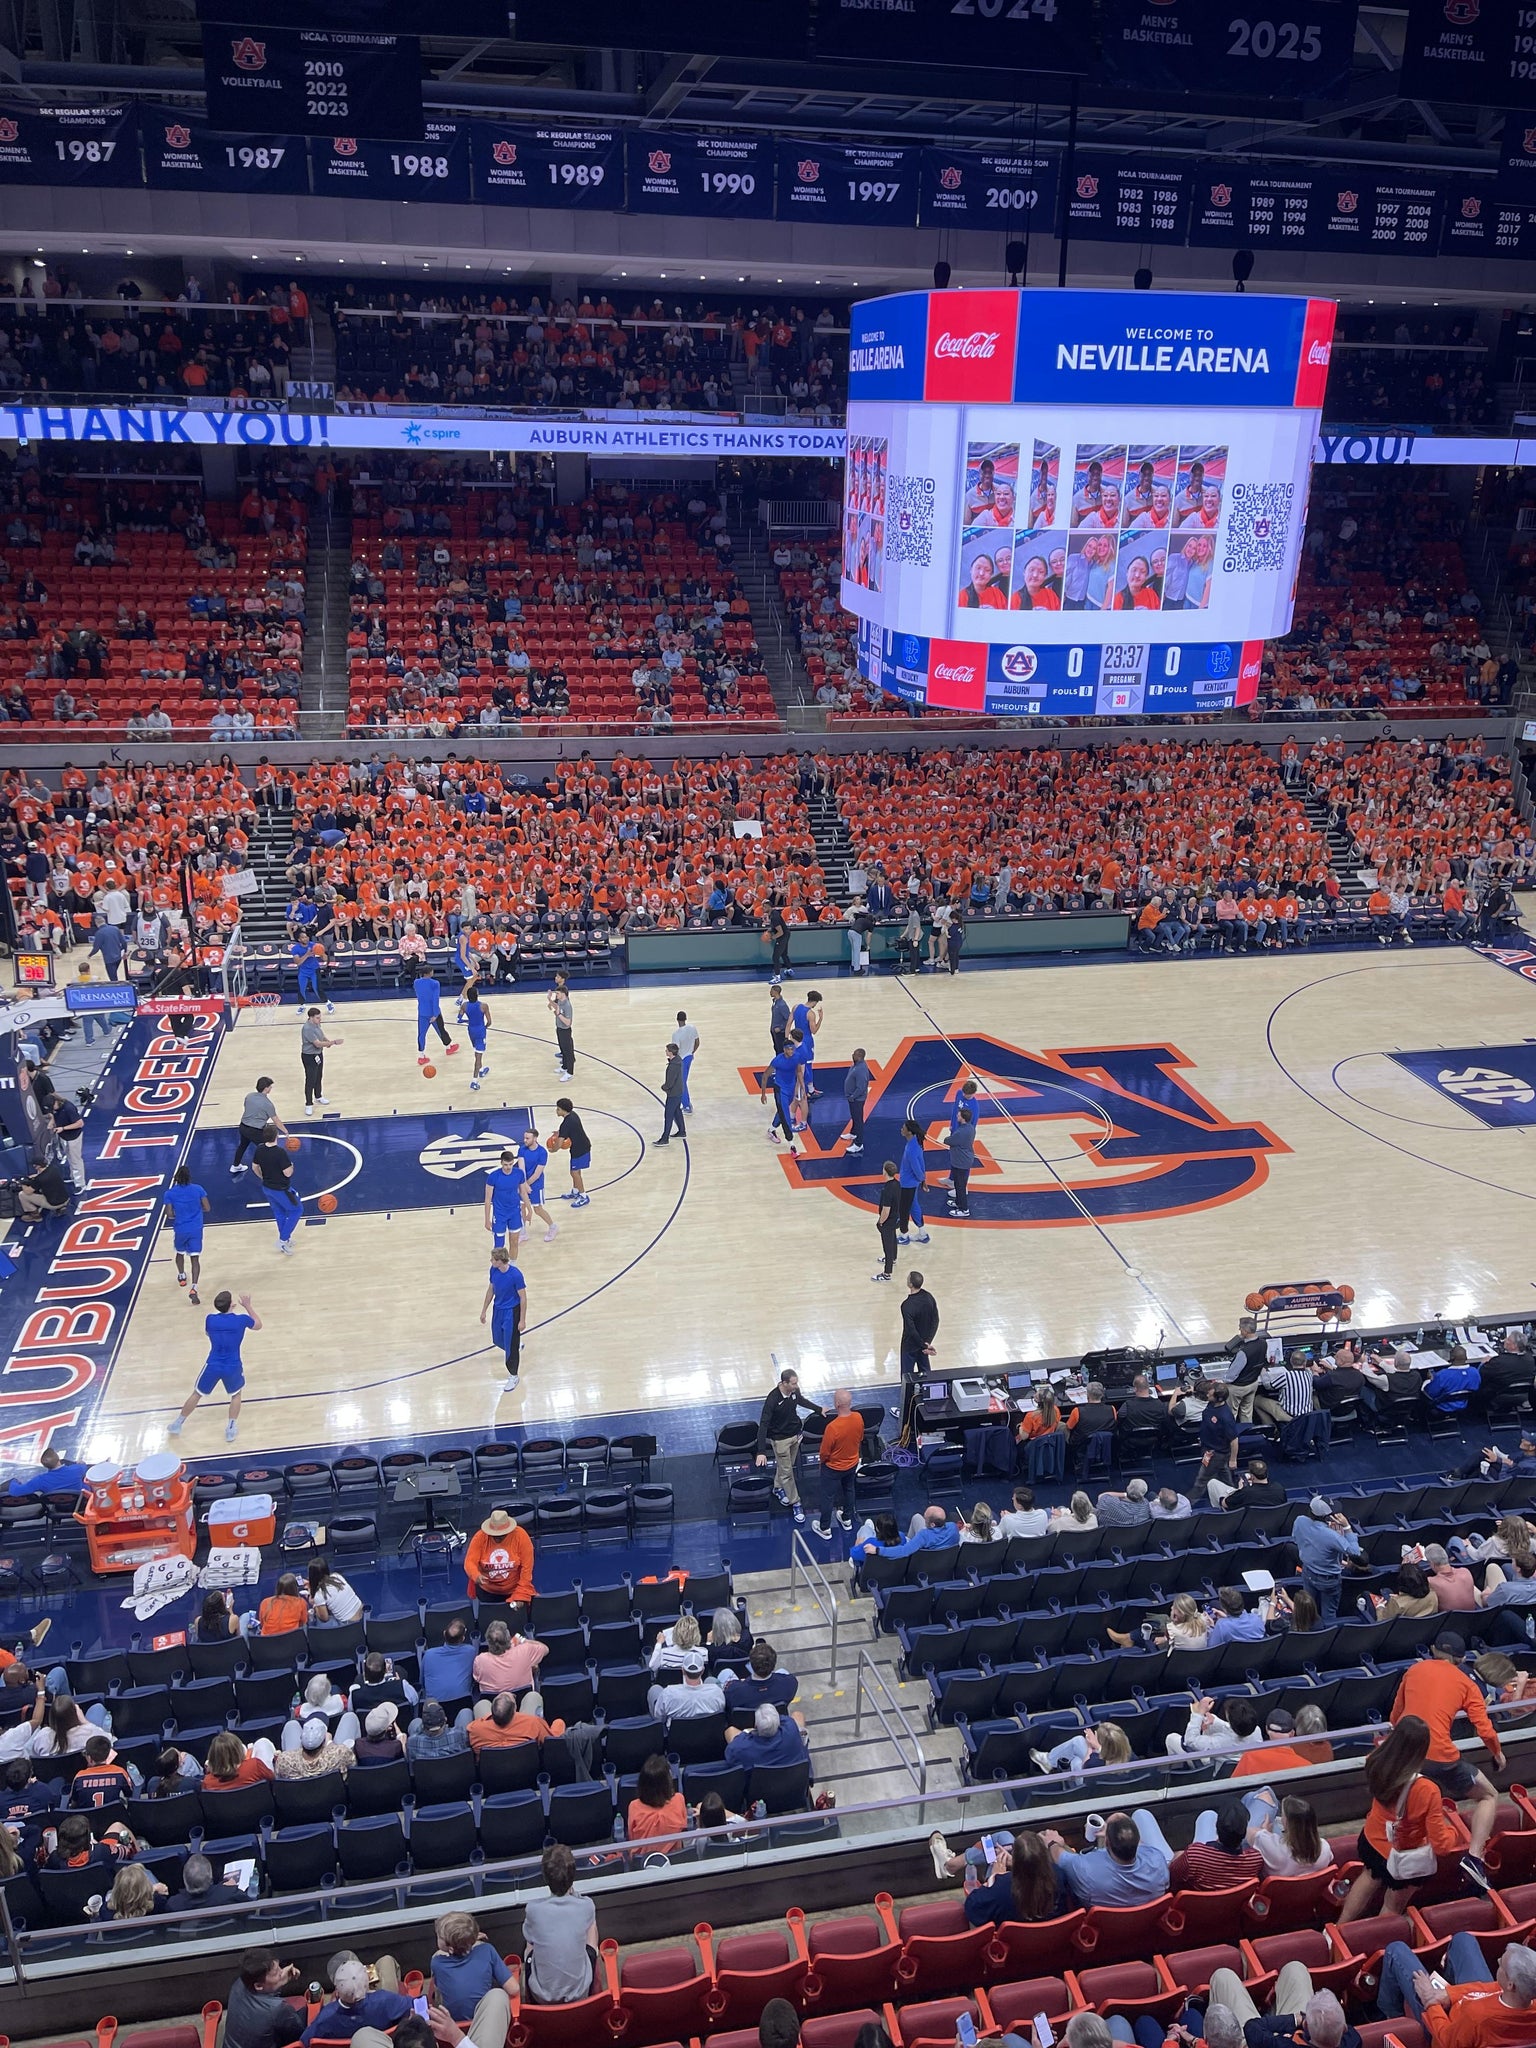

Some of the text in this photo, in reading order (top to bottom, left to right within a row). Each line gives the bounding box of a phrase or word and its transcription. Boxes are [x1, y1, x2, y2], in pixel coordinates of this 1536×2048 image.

[1140, 14, 1178, 28] MEN'S
[301, 32, 397, 45] NCAA TOURNAMENT
[1123, 27, 1193, 46] BASKETBALL
[1227, 18, 1321, 61] 2025
[1439, 32, 1473, 46] MEN'S
[1424, 46, 1486, 62] BASKETBALL
[305, 61, 343, 77] 2010
[221, 76, 283, 89] VOLLEYBALL
[306, 81, 348, 97] 2022
[307, 100, 349, 117] 2023
[59, 117, 106, 126] CHAMPIONS
[427, 124, 456, 132] SEASON
[550, 132, 582, 140] REGULAR
[584, 133, 611, 141] SEASON
[553, 140, 596, 149] CHAMPIONS
[711, 141, 757, 150] TOURNAMENT
[55, 141, 116, 162] 1987
[164, 153, 199, 161] WOMEN'S
[226, 147, 285, 168] 1987
[706, 149, 748, 158] CHAMPIONS
[857, 150, 903, 159] TOURNAMENT
[161, 161, 203, 169] BASKETBALL
[331, 160, 365, 168] WOMEN'S
[391, 155, 449, 178] 1988
[854, 159, 894, 167] CHAMPIONS
[328, 168, 368, 177] BASKETBALL
[490, 169, 523, 177] WOMEN'S
[549, 164, 604, 187] 1989
[1118, 170, 1183, 181] NCAA TOURNAMENT
[488, 177, 526, 186] BASKETBALL
[645, 177, 676, 186] WOMEN'S
[701, 173, 755, 195] 1990
[1250, 180, 1312, 190] NCAA TOURNAMENT
[642, 185, 679, 194] BASKETBALL
[794, 186, 824, 194] WOMEN'S
[849, 181, 900, 202] 1997
[1119, 188, 1178, 202] 1982 1986
[1376, 186, 1436, 197] NCAA TOURNAMENT
[790, 194, 827, 202] BASKETBALL
[1251, 197, 1308, 210] 1989 1993
[1071, 202, 1100, 210] WOMEN'S
[1118, 202, 1177, 216] 1983 1987
[1377, 203, 1431, 216] 1997 2004
[1116, 216, 1175, 229] 1985 1988
[1250, 210, 1306, 223] 1990 1994
[1375, 216, 1429, 229] 1999 2008
[1499, 211, 1521, 222] 2016
[1248, 223, 1305, 236] 1991 1996
[1497, 224, 1521, 234] 2017
[1372, 230, 1427, 242] 2000 2009
[1495, 236, 1519, 246] 2019
[1126, 328, 1214, 341] WELCOME TO
[873, 344, 904, 370] ARENA
[1057, 344, 1270, 373] NEVILLE ARENA
[2, 404, 330, 447] THANK YOU!
[529, 428, 847, 450] AUBURN ATHLETICS THANKS TODAY
[1319, 437, 1415, 465] YOU!
[1067, 647, 1084, 678] 0
[1104, 645, 1144, 669] 23:37
[1165, 646, 1181, 677] 0
[1109, 675, 1136, 684] PREGAME
[1003, 685, 1031, 695] AUBURN
[1053, 688, 1078, 696] FOULS
[1163, 686, 1188, 694] FOULS
[1203, 681, 1229, 692] KENTUCKY
[1115, 694, 1126, 705] 30
[1196, 699, 1225, 709] TIMEOUTS
[991, 702, 1028, 711] TIMEOUTS
[1382, 725, 1392, 736] G
[1051, 733, 1061, 745] H
[110, 748, 121, 761] K
[557, 743, 563, 755] J
[81, 991, 130, 1002] RENASANT
[1290, 1295, 1322, 1304] AUBURN
[95, 1487, 107, 1499] G
[153, 1486, 165, 1498] G
[232, 1523, 248, 1538] G
[92, 1791, 104, 1807] 1
